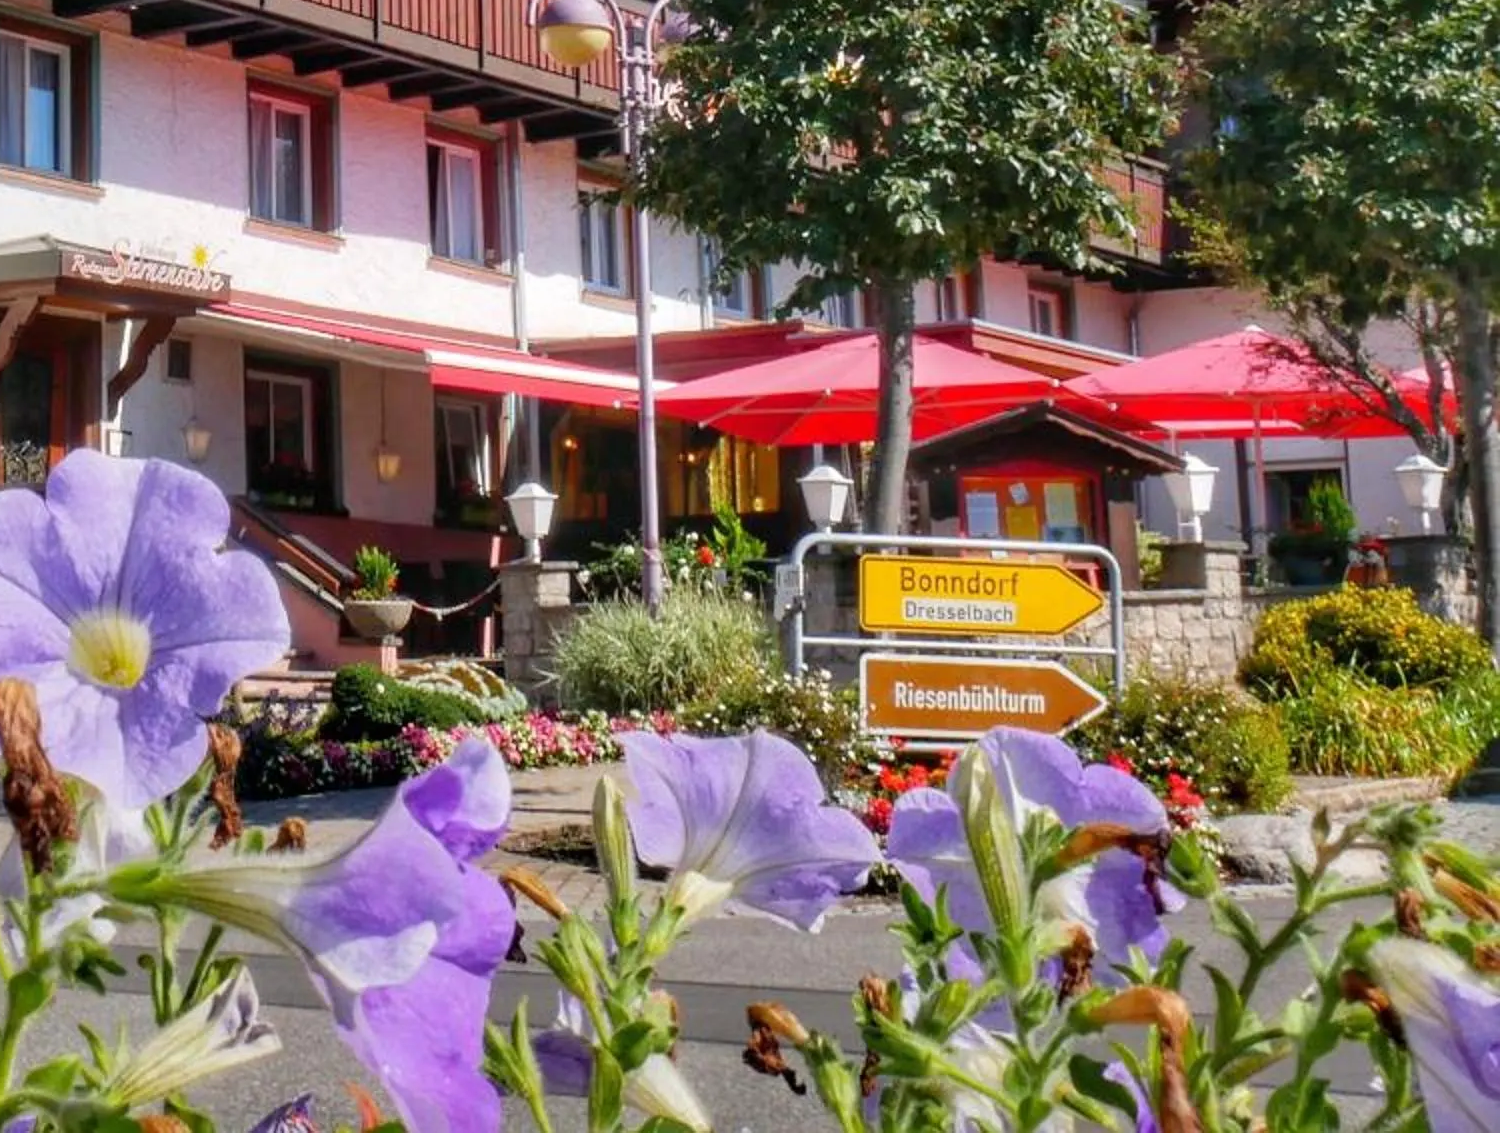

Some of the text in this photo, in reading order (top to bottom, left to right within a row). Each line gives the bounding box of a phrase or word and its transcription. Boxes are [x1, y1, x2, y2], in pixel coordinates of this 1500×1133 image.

[900, 566, 1019, 596] Bonndorf
[904, 599, 1014, 623] Dresselbach
[894, 681, 1046, 715] Riesenbühlturm
